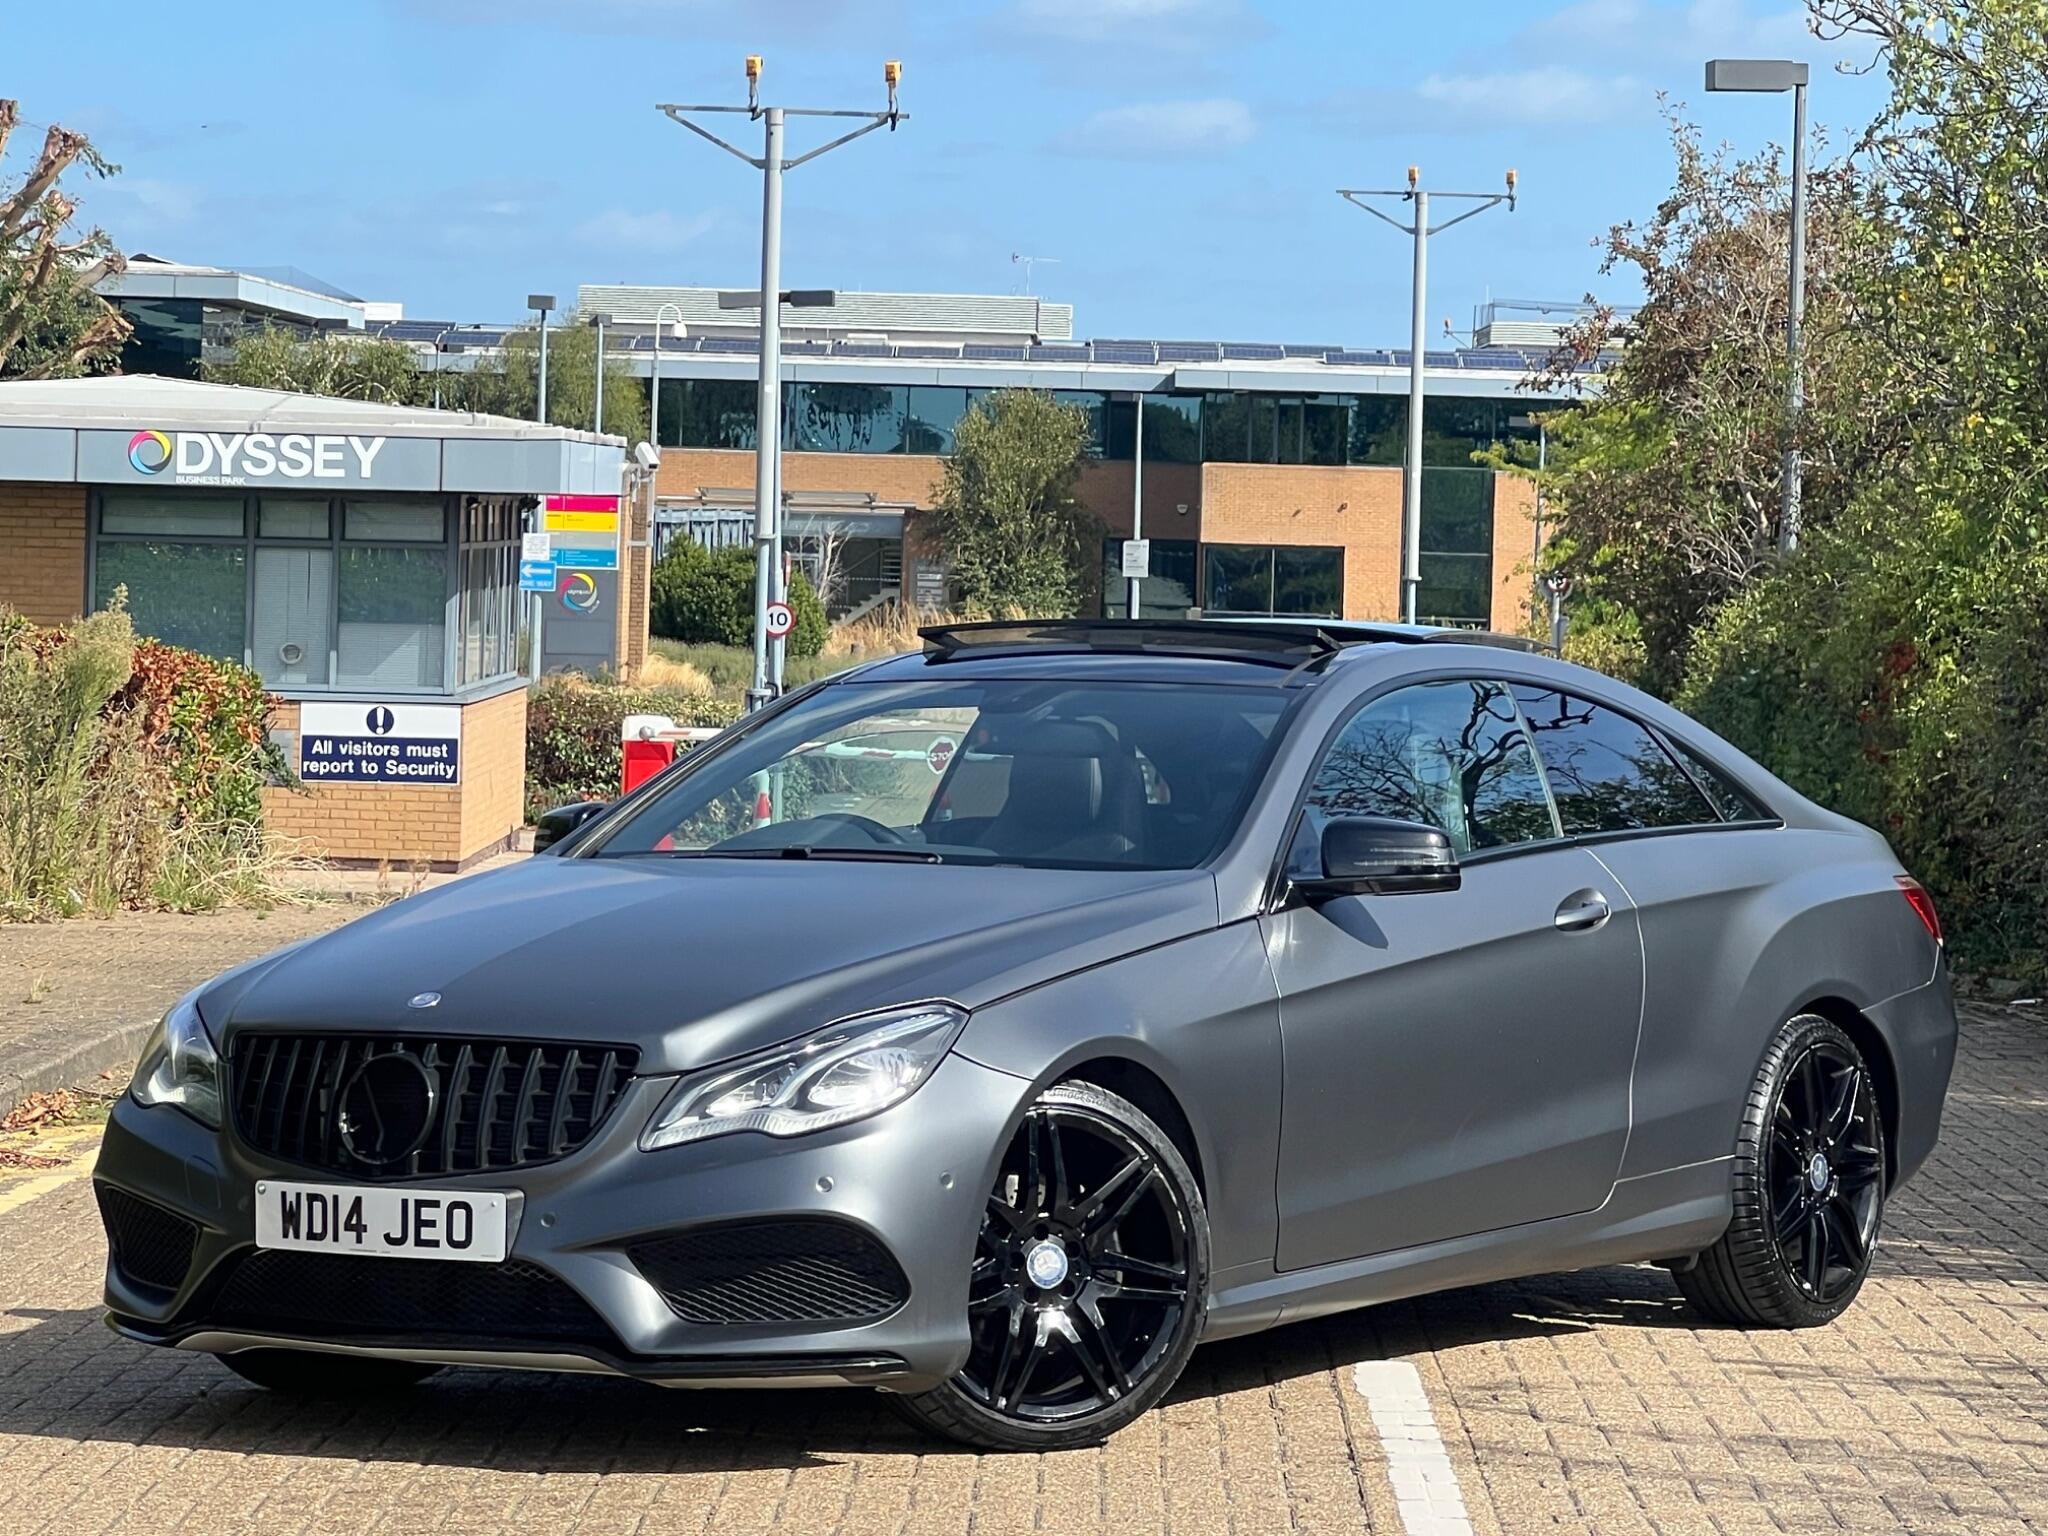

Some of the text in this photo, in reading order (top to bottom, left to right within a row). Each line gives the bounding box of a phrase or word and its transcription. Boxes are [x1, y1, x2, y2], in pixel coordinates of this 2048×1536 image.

[175, 474, 247, 487] BUSINESS PARK
[769, 612, 788, 626] 10
[312, 739, 448, 758] All visitors must
[303, 759, 456, 779] report to Security
[280, 1190, 473, 1250] WD14 JEO
